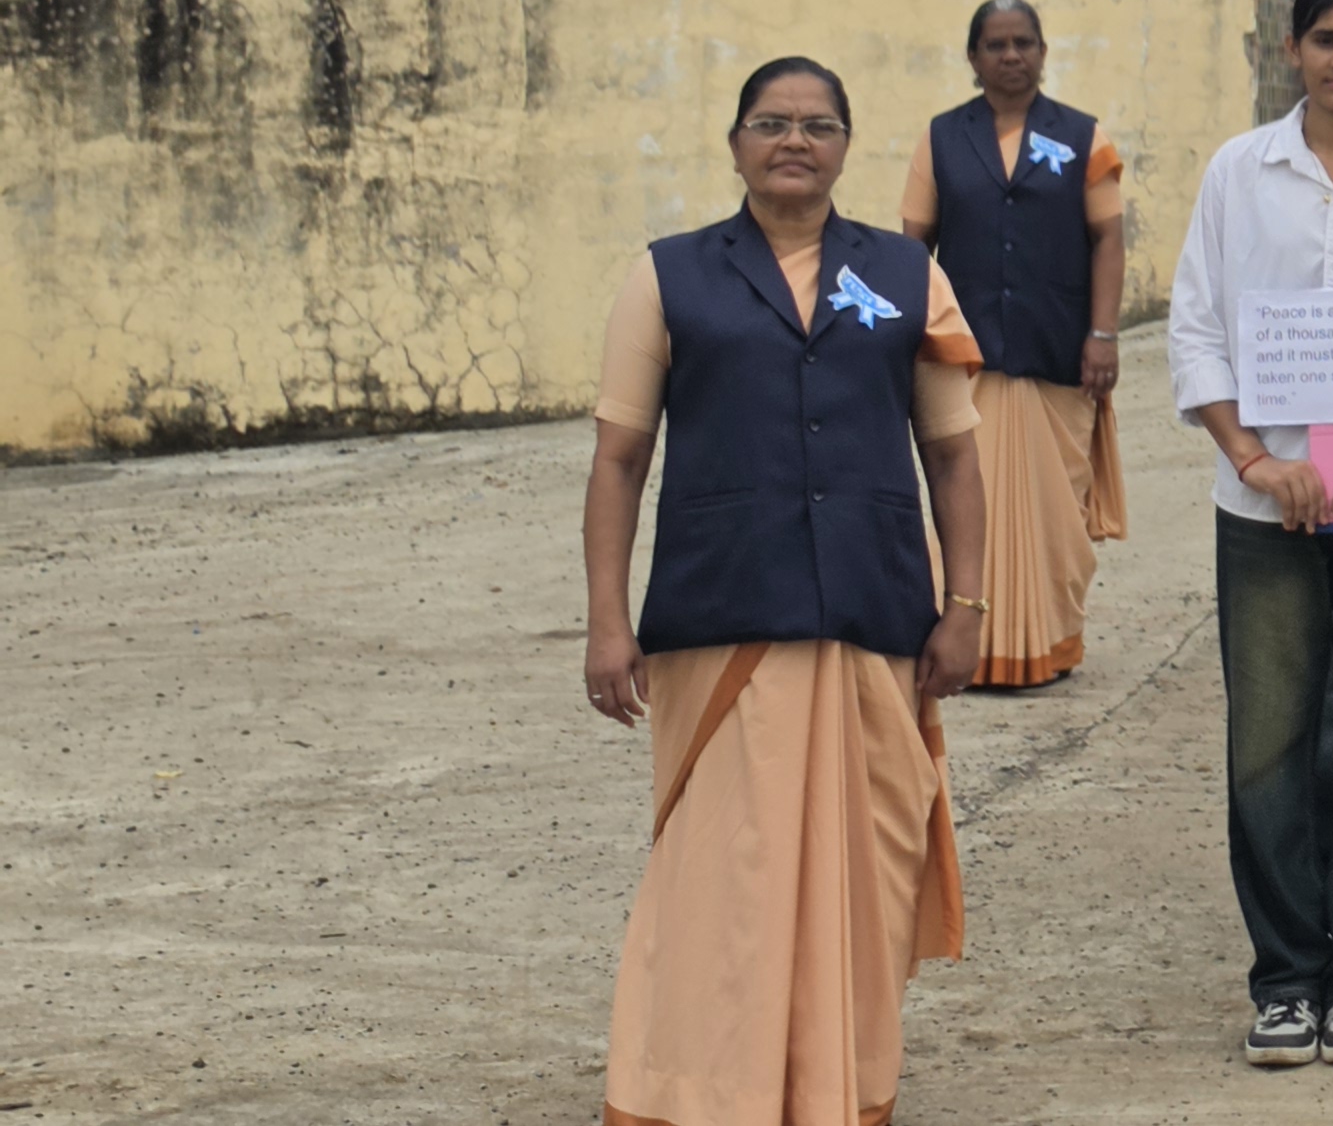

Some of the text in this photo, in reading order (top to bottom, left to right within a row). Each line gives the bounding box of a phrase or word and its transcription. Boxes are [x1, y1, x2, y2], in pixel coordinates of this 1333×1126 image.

[1256, 305, 1307, 320] "Peace
[1311, 305, 1323, 319] is
[1256, 327, 1270, 342] of
[1274, 330, 1283, 341] a
[1256, 349, 1283, 363] and
[1288, 349, 1296, 362] it
[1300, 348, 1333, 362] must
[1257, 371, 1296, 385] taken
[1300, 371, 1327, 384] one
[1257, 391, 1297, 406] time."
